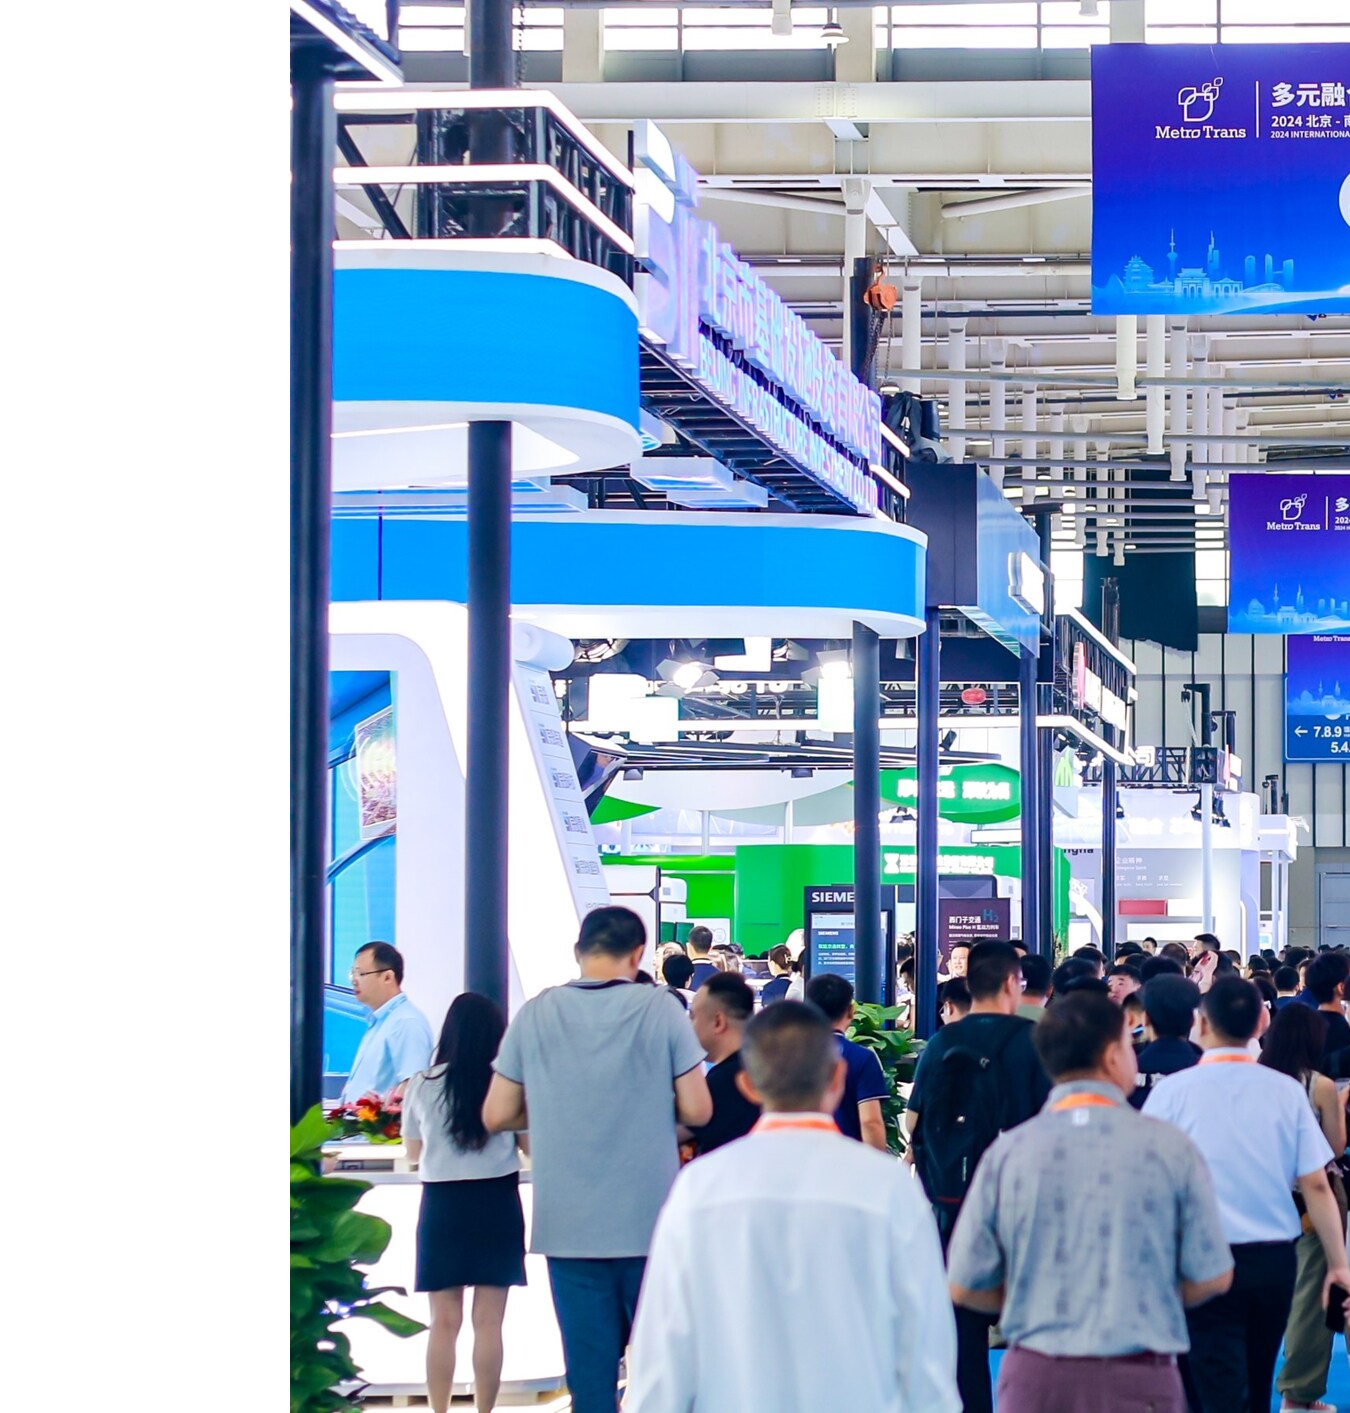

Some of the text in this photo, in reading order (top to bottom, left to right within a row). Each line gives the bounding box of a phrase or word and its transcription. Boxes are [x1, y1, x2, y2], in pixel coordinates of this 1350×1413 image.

[1271, 115, 1303, 128] 2024
[1305, 114, 1333, 128] 北京
[1155, 125, 1246, 139] Metro Trans
[1270, 130, 1290, 139] 2024
[1266, 521, 1321, 531] Metro Trans
[1313, 725, 1342, 738] 7.8.9
